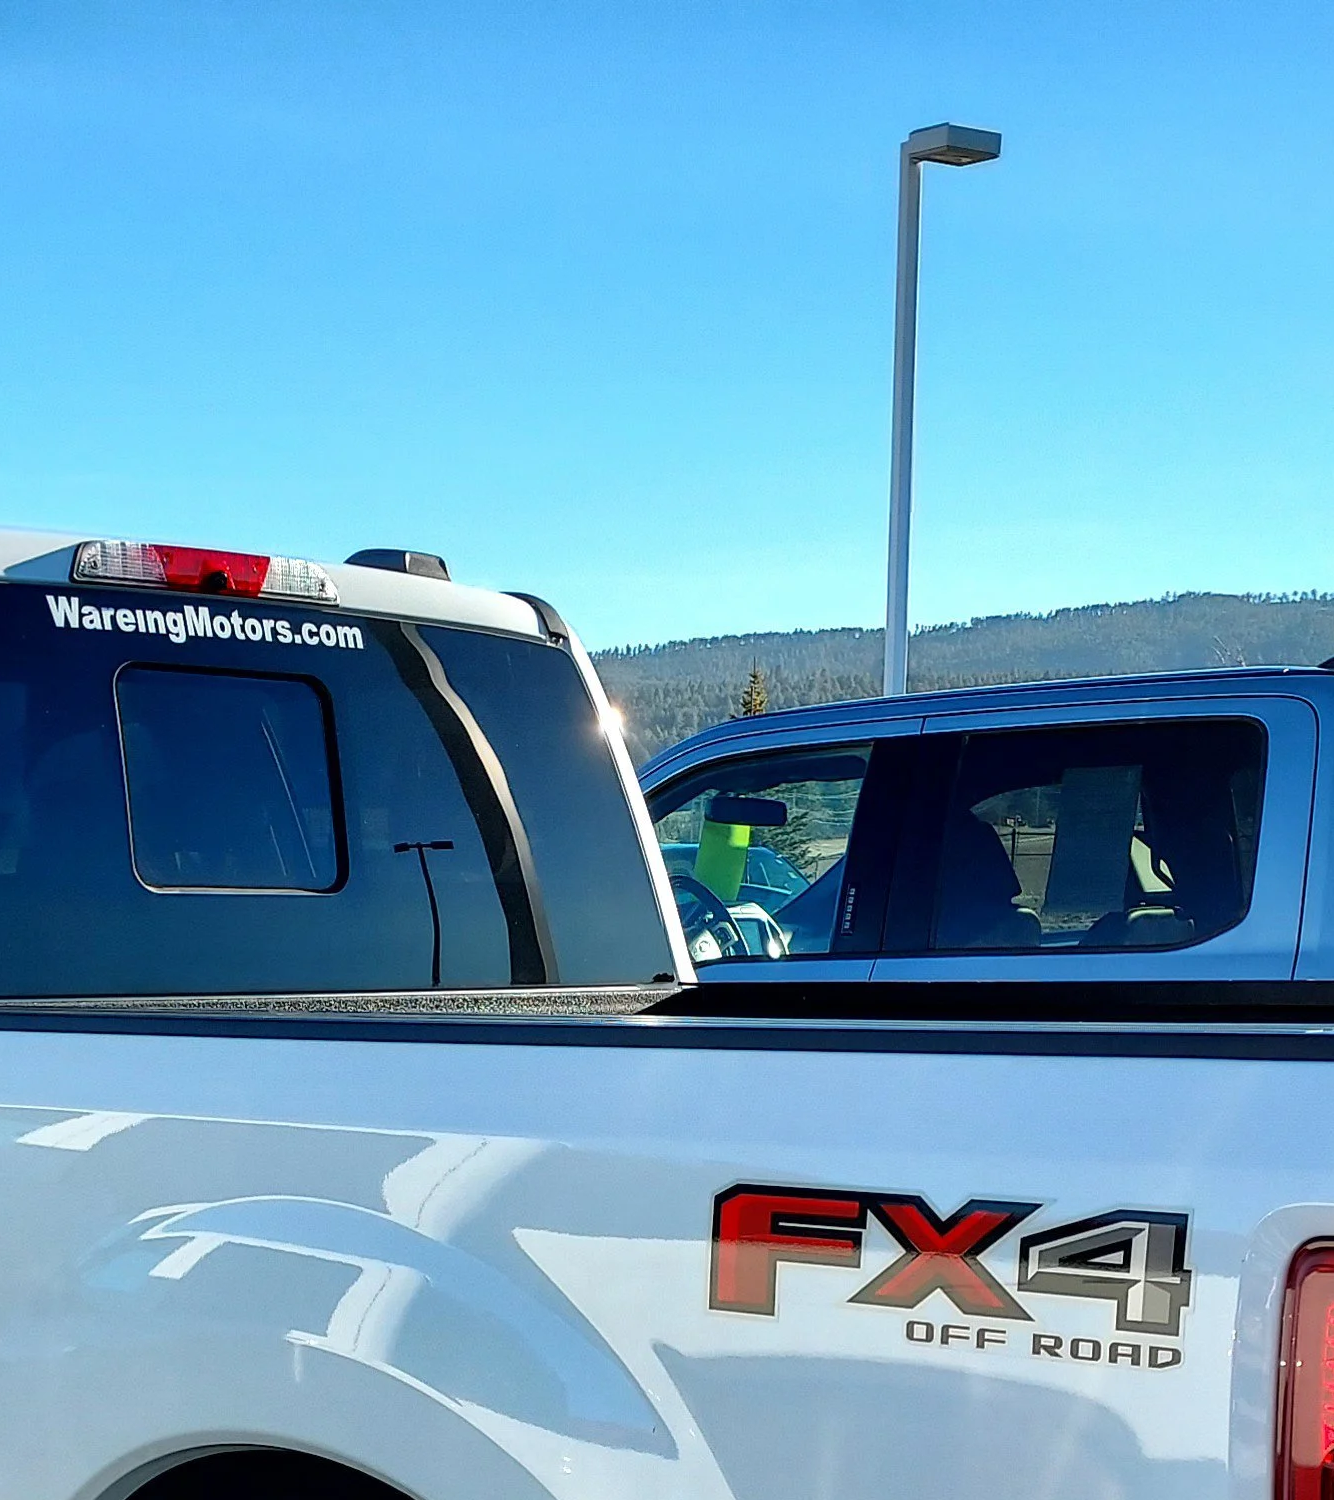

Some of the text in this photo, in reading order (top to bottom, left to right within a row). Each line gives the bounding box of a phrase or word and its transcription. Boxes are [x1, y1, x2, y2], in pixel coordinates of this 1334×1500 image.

[45, 594, 364, 650] WareingMotors.com
[708, 1182, 1193, 1338] FX4
[905, 1319, 1183, 1370] OFF ROAD
